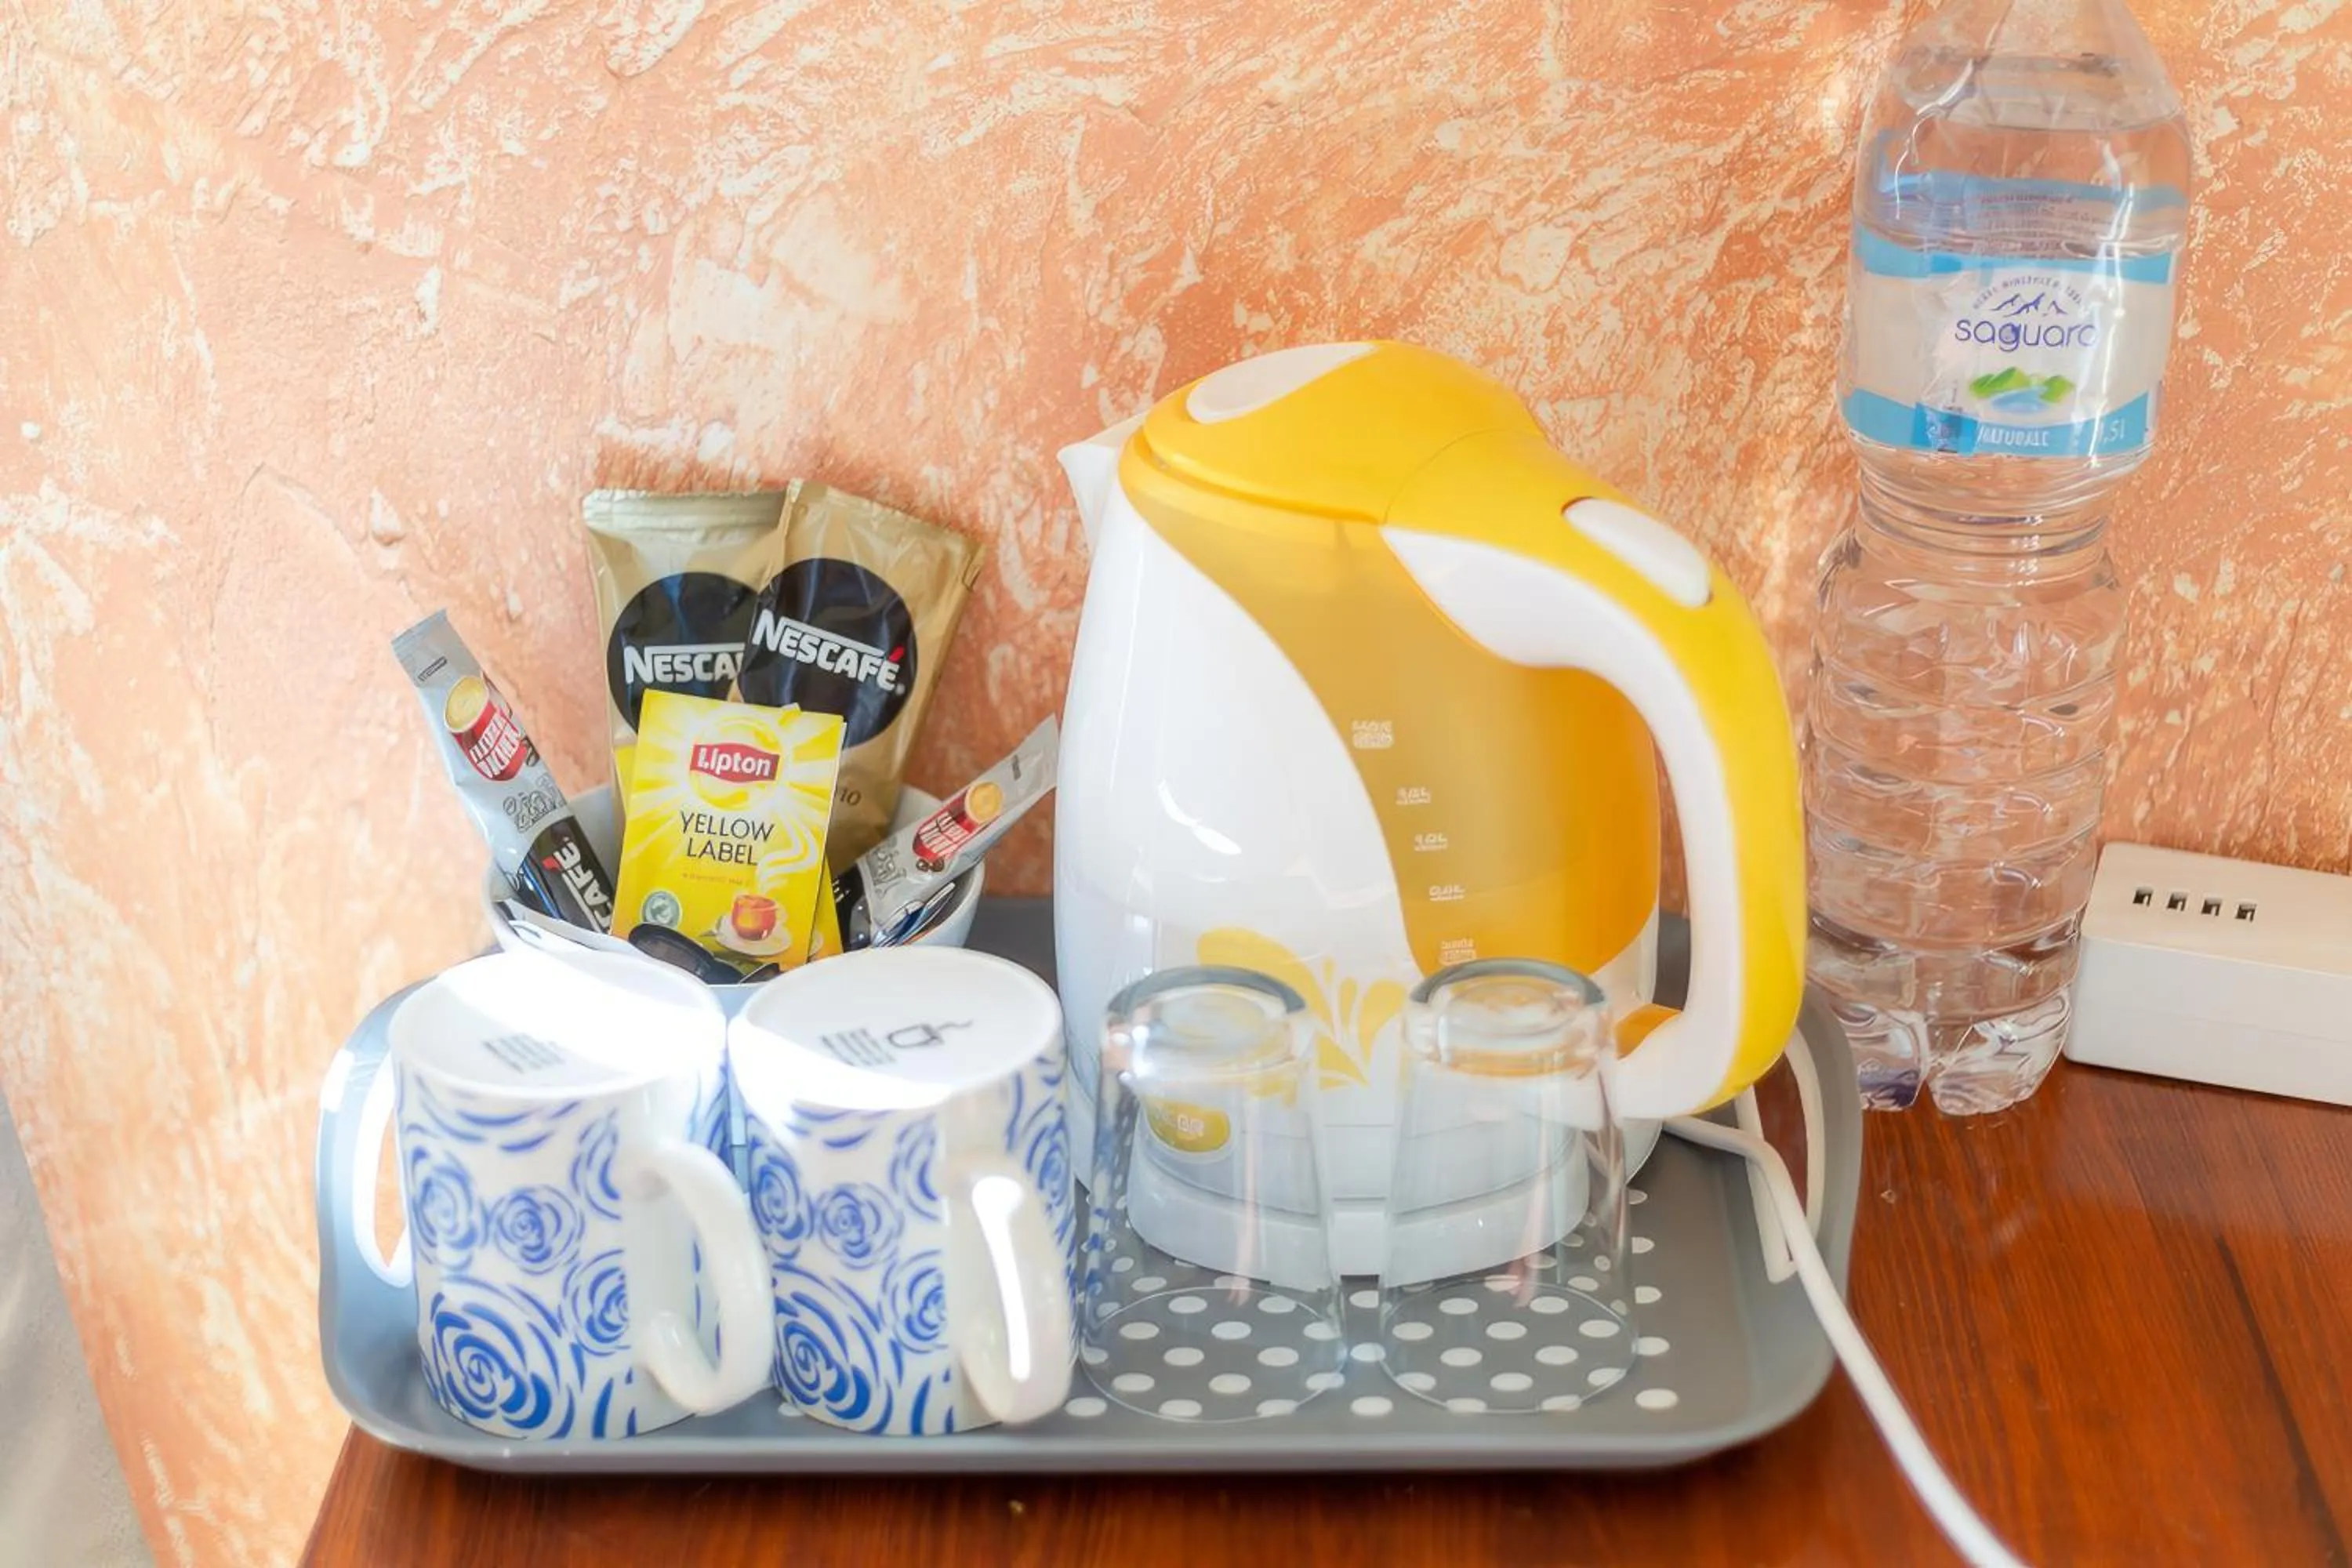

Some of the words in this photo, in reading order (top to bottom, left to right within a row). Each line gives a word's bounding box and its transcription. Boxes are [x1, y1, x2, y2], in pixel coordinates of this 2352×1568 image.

[1955, 319, 2096, 353] saguaro
[622, 641, 745, 684] NESCA
[697, 747, 772, 777] Lipton
[680, 810, 775, 843] YELLOW
[686, 837, 758, 867] LABEL
